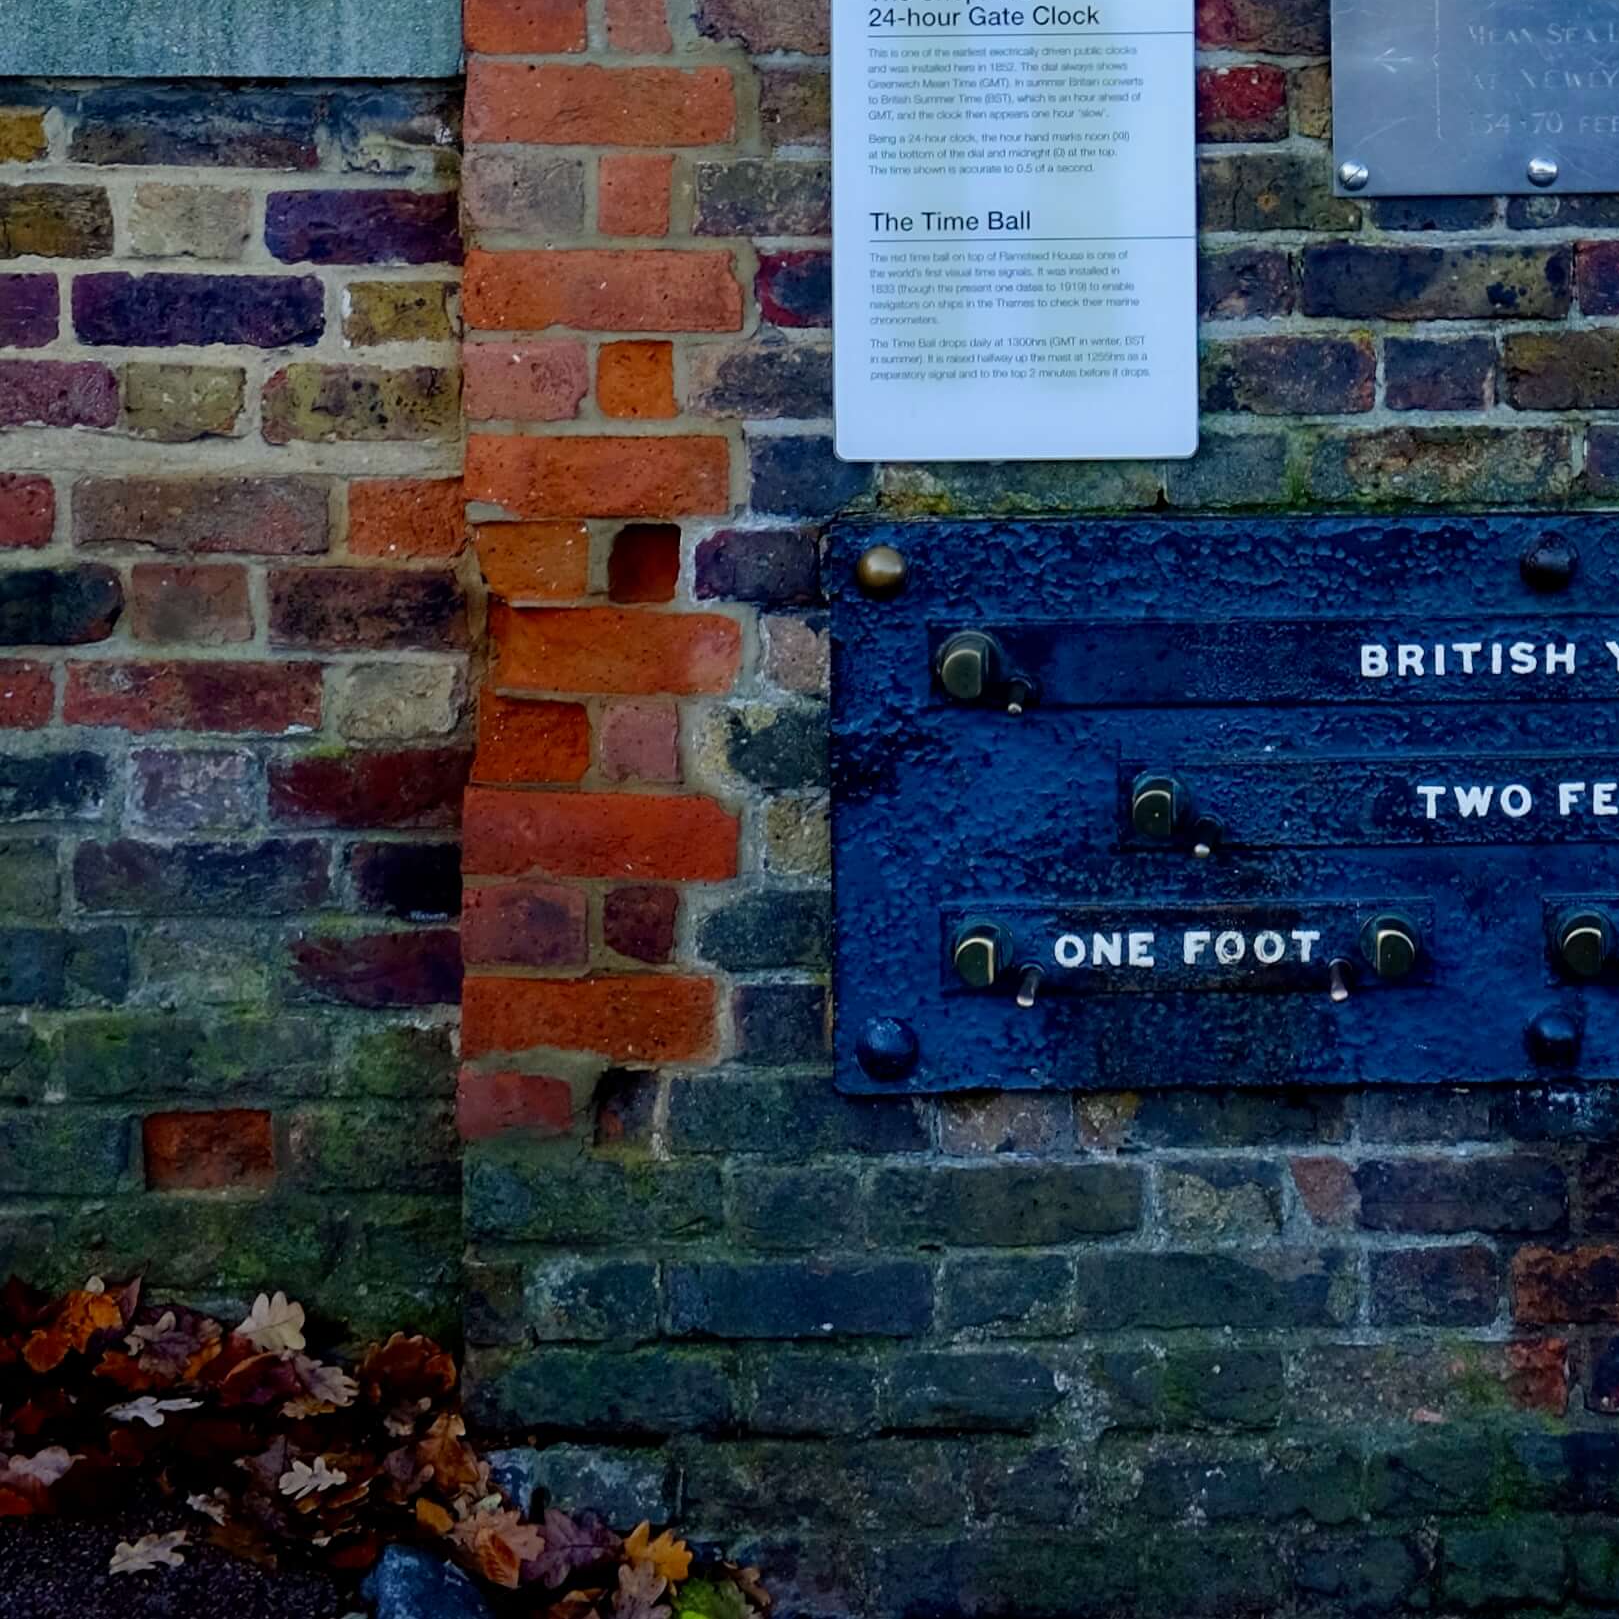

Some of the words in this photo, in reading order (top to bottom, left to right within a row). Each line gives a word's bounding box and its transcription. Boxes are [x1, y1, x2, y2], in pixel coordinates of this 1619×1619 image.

[869, 7, 961, 27] 24-hour
[968, 6, 1025, 27] Gate
[1032, 5, 1099, 26] Clock
[869, 212, 913, 232] The
[921, 211, 979, 231] Time
[988, 210, 1031, 231] Ball
[1360, 641, 1576, 677] BRITISH
[1416, 784, 1532, 819] TWO
[1051, 929, 1155, 970] ONE
[1182, 927, 1322, 968] FOOT
